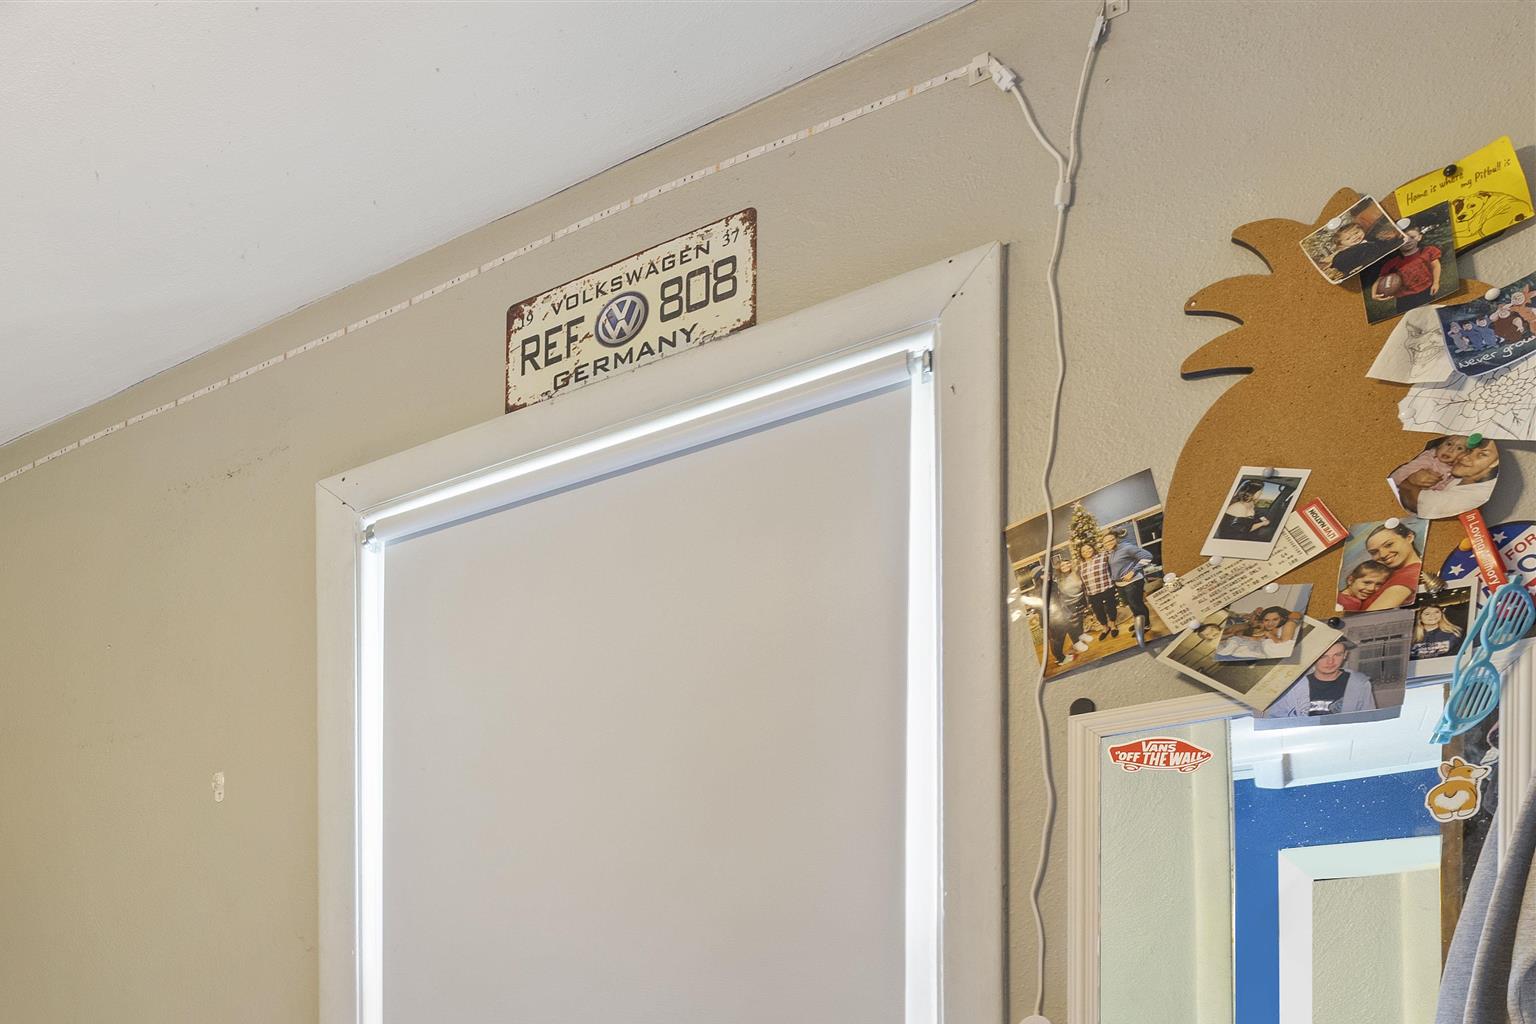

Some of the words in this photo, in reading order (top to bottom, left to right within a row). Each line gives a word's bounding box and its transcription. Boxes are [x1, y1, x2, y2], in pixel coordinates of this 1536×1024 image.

[1406, 190, 1428, 206] Home
[1430, 184, 1437, 193] is
[551, 240, 710, 315] VOLKSWAGEN
[521, 315, 585, 377] REF
[659, 254, 738, 323] 808
[553, 323, 698, 391] GERMANY
[1308, 509, 1327, 528] NATION
[1466, 513, 1477, 522] In
[1324, 526, 1337, 539] LIVE
[1468, 520, 1485, 552] Loving
[1505, 533, 1536, 560] FOR
[1480, 548, 1500, 585] mory
[1115, 750, 1141, 763] "OFF
[1142, 752, 1167, 766] THE
[1169, 750, 1208, 766] WALL"
[1141, 741, 1177, 753] VANS
